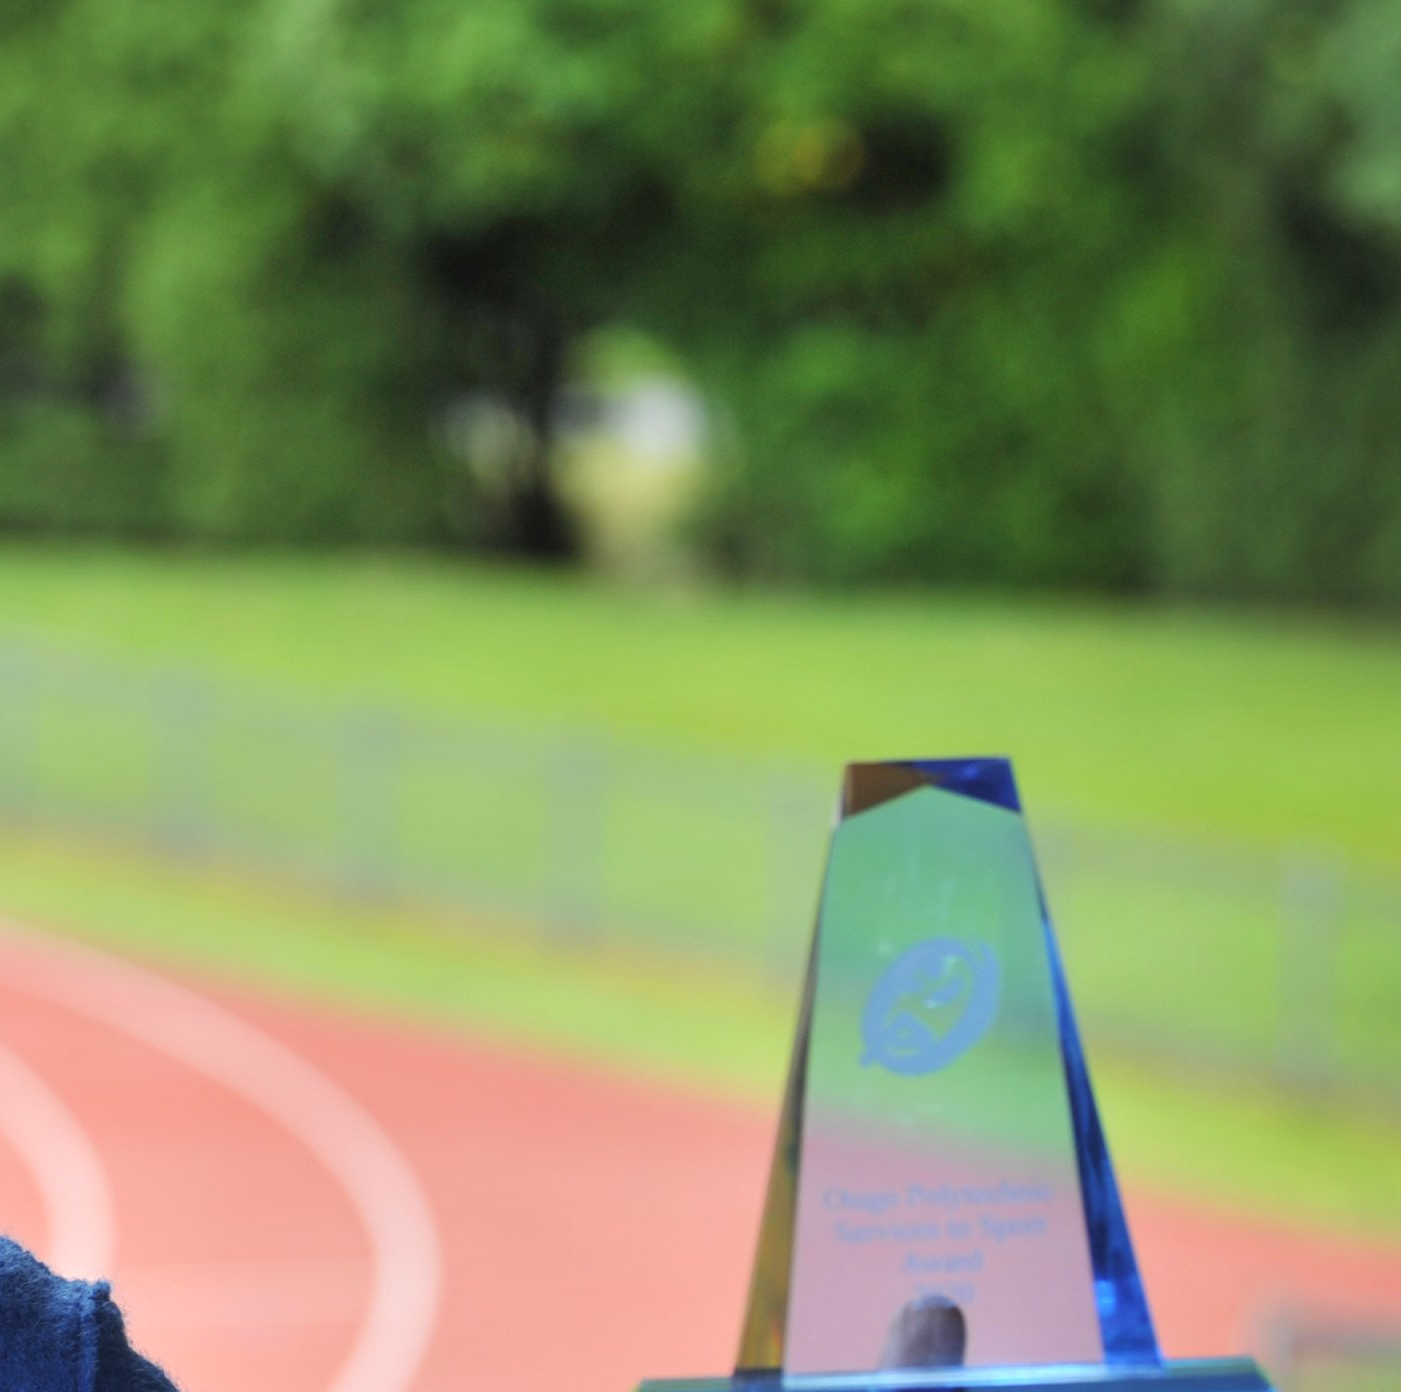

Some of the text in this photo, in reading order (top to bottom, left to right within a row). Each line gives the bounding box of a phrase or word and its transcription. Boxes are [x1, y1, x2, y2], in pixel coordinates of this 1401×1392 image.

[824, 1183, 1053, 1214] Otago Polytechnic
[947, 1220, 972, 1240] to
[980, 1215, 1046, 1242] Sport
[901, 1249, 982, 1273] Award
